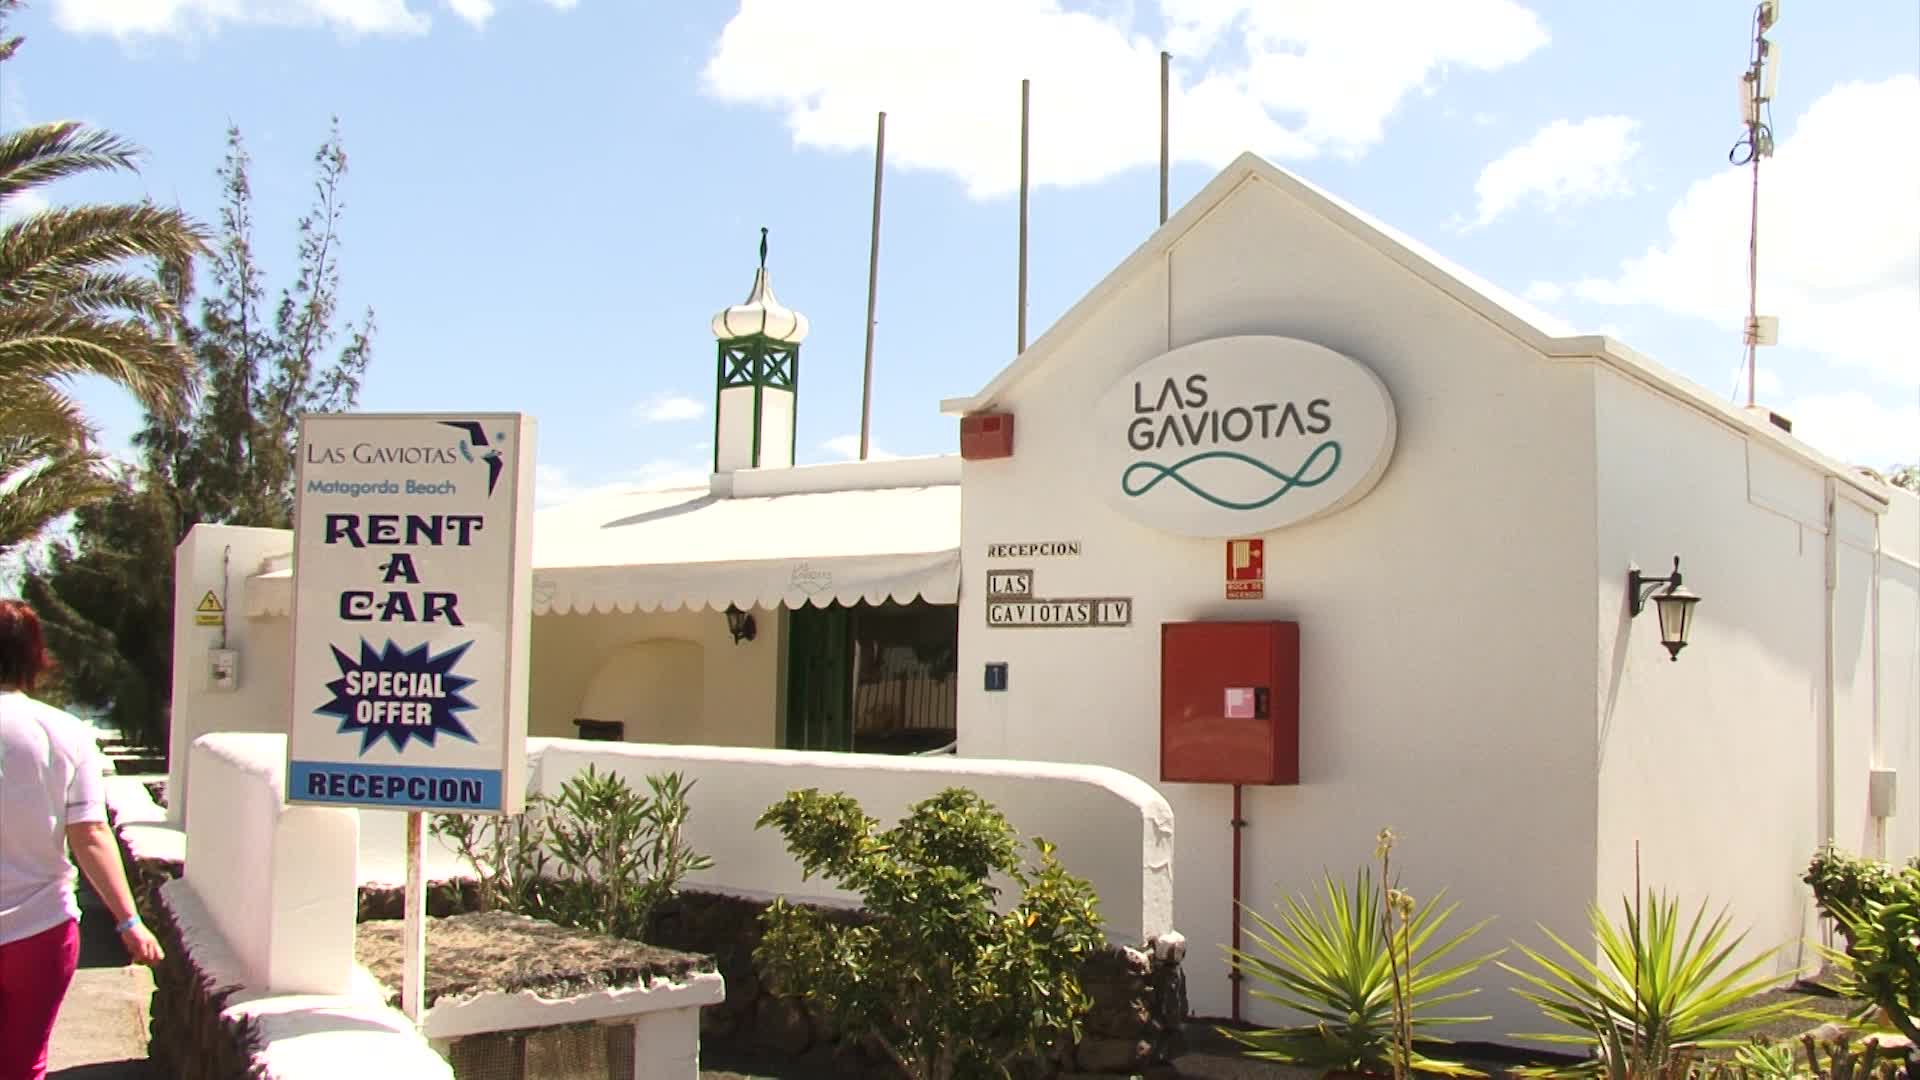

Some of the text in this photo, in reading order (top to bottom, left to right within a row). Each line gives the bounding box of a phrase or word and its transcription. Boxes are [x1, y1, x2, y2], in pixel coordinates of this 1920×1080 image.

[1134, 374, 1208, 414] LAS
[1127, 398, 1332, 451] GAVIOTAS
[307, 442, 457, 464] LAS GAVIOTAS
[307, 479, 456, 498] Matagorda Beach
[324, 514, 484, 548] RENT
[987, 541, 1079, 558] RECEPCION
[378, 553, 420, 584] A
[992, 575, 1027, 593] LAS
[340, 591, 465, 627] CAR
[991, 603, 1125, 622] GAVIOTAS IV
[346, 670, 447, 698] SPECIAL
[356, 700, 433, 726] OFFER
[308, 772, 484, 804] RECEPCION
